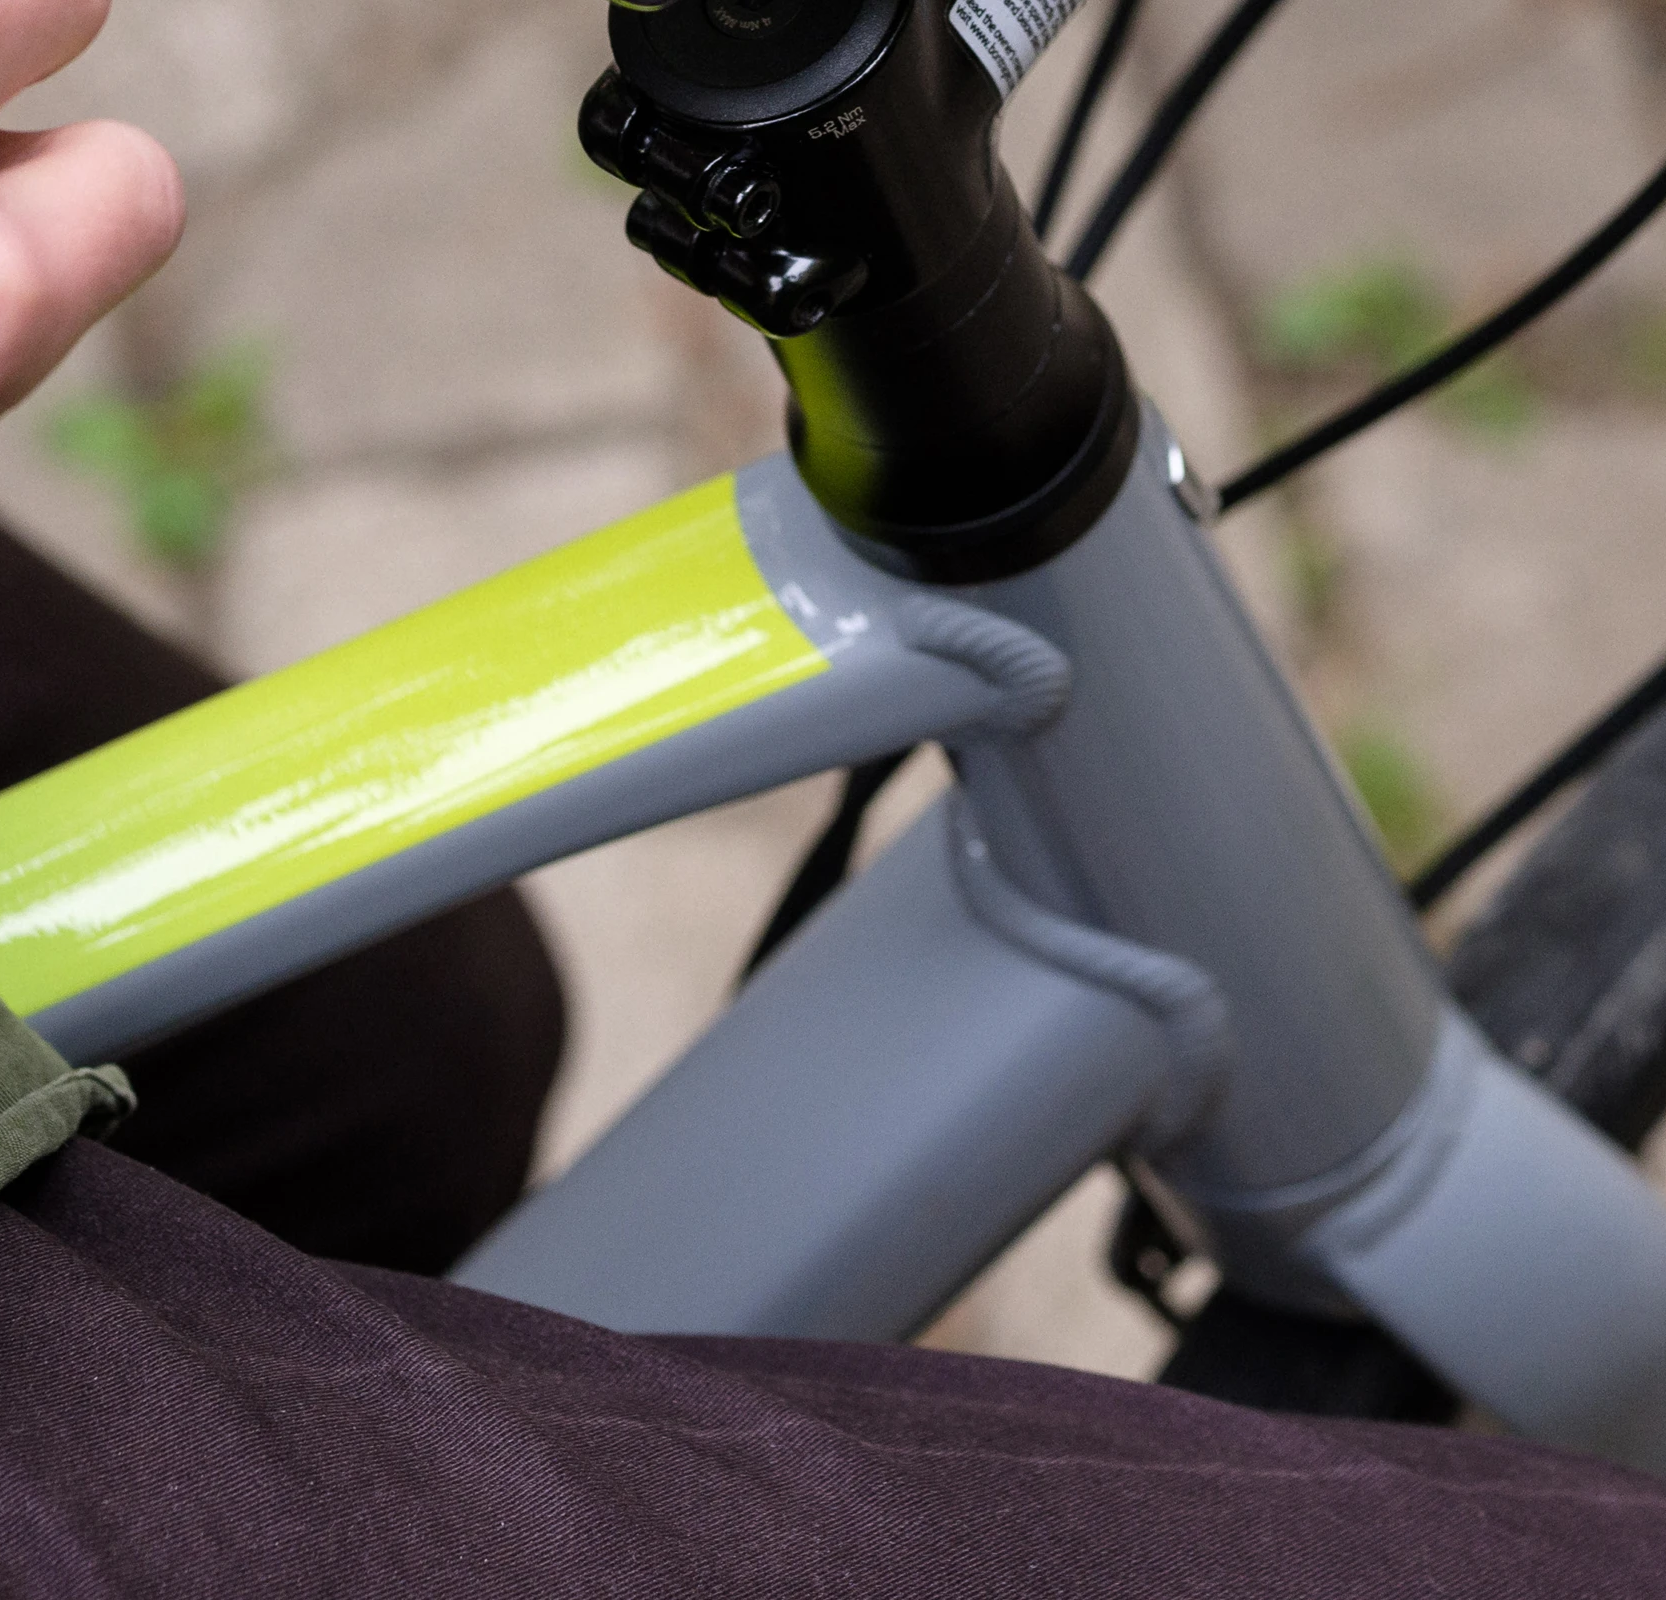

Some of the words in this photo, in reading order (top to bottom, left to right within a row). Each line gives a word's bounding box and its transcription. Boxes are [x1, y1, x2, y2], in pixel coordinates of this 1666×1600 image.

[739, 19, 760, 32] Nm
[955, 4, 974, 26] visit
[982, 13, 997, 33] the
[807, 120, 837, 139] 5.2
[837, 106, 863, 126] Nm
[833, 115, 867, 139] Max
